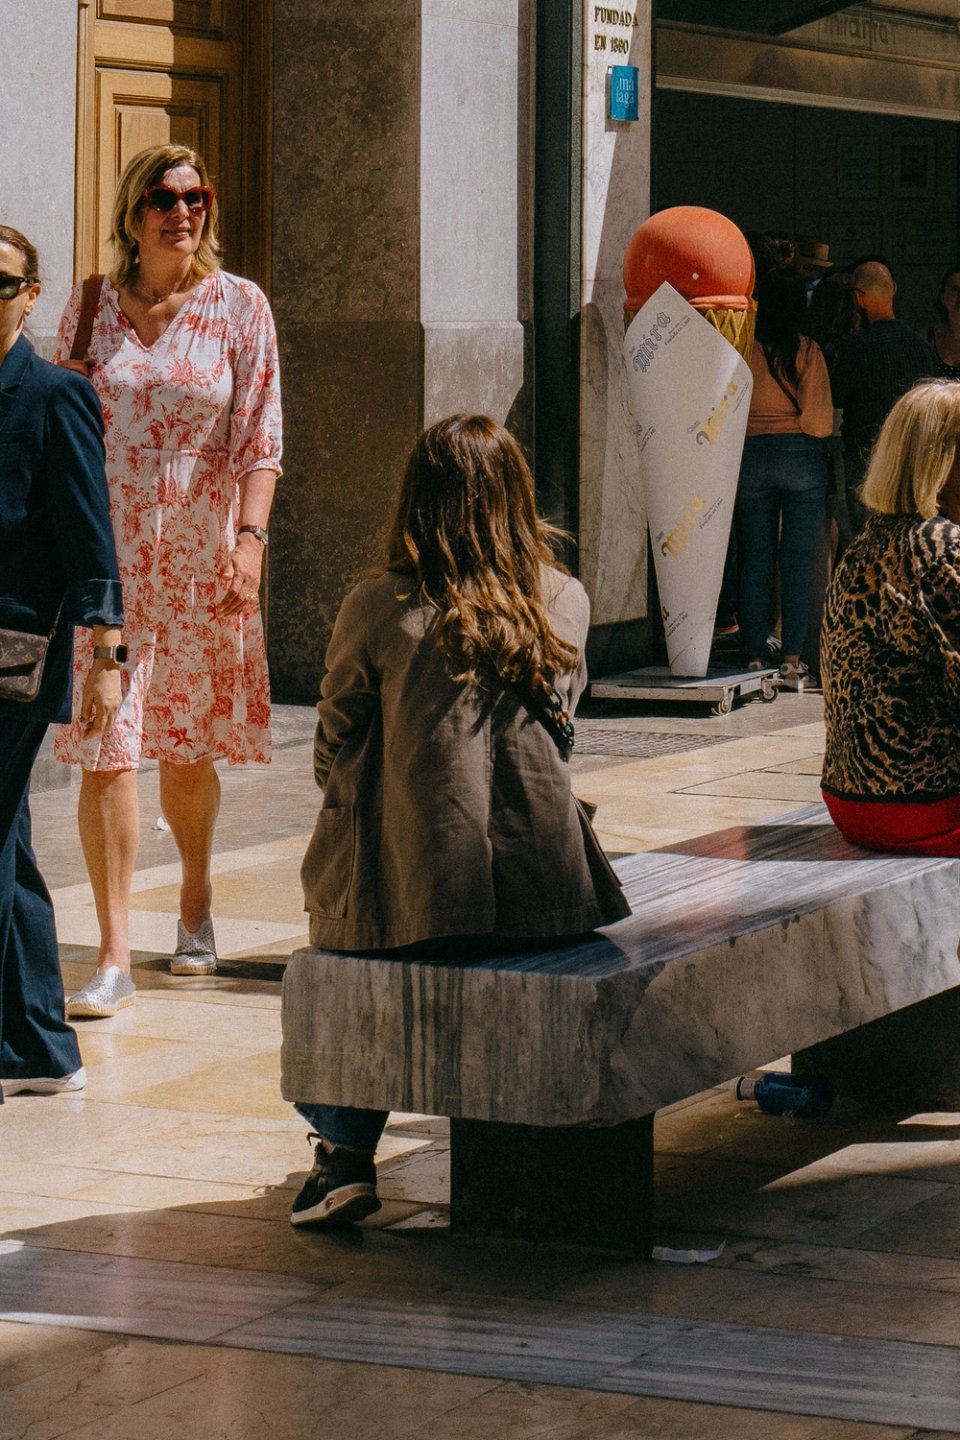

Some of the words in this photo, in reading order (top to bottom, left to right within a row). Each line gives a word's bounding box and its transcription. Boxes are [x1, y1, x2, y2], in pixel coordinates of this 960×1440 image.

[594, 6, 639, 27] FUNDADA
[594, 33, 607, 51] EN
[632, 311, 671, 373] Mira
